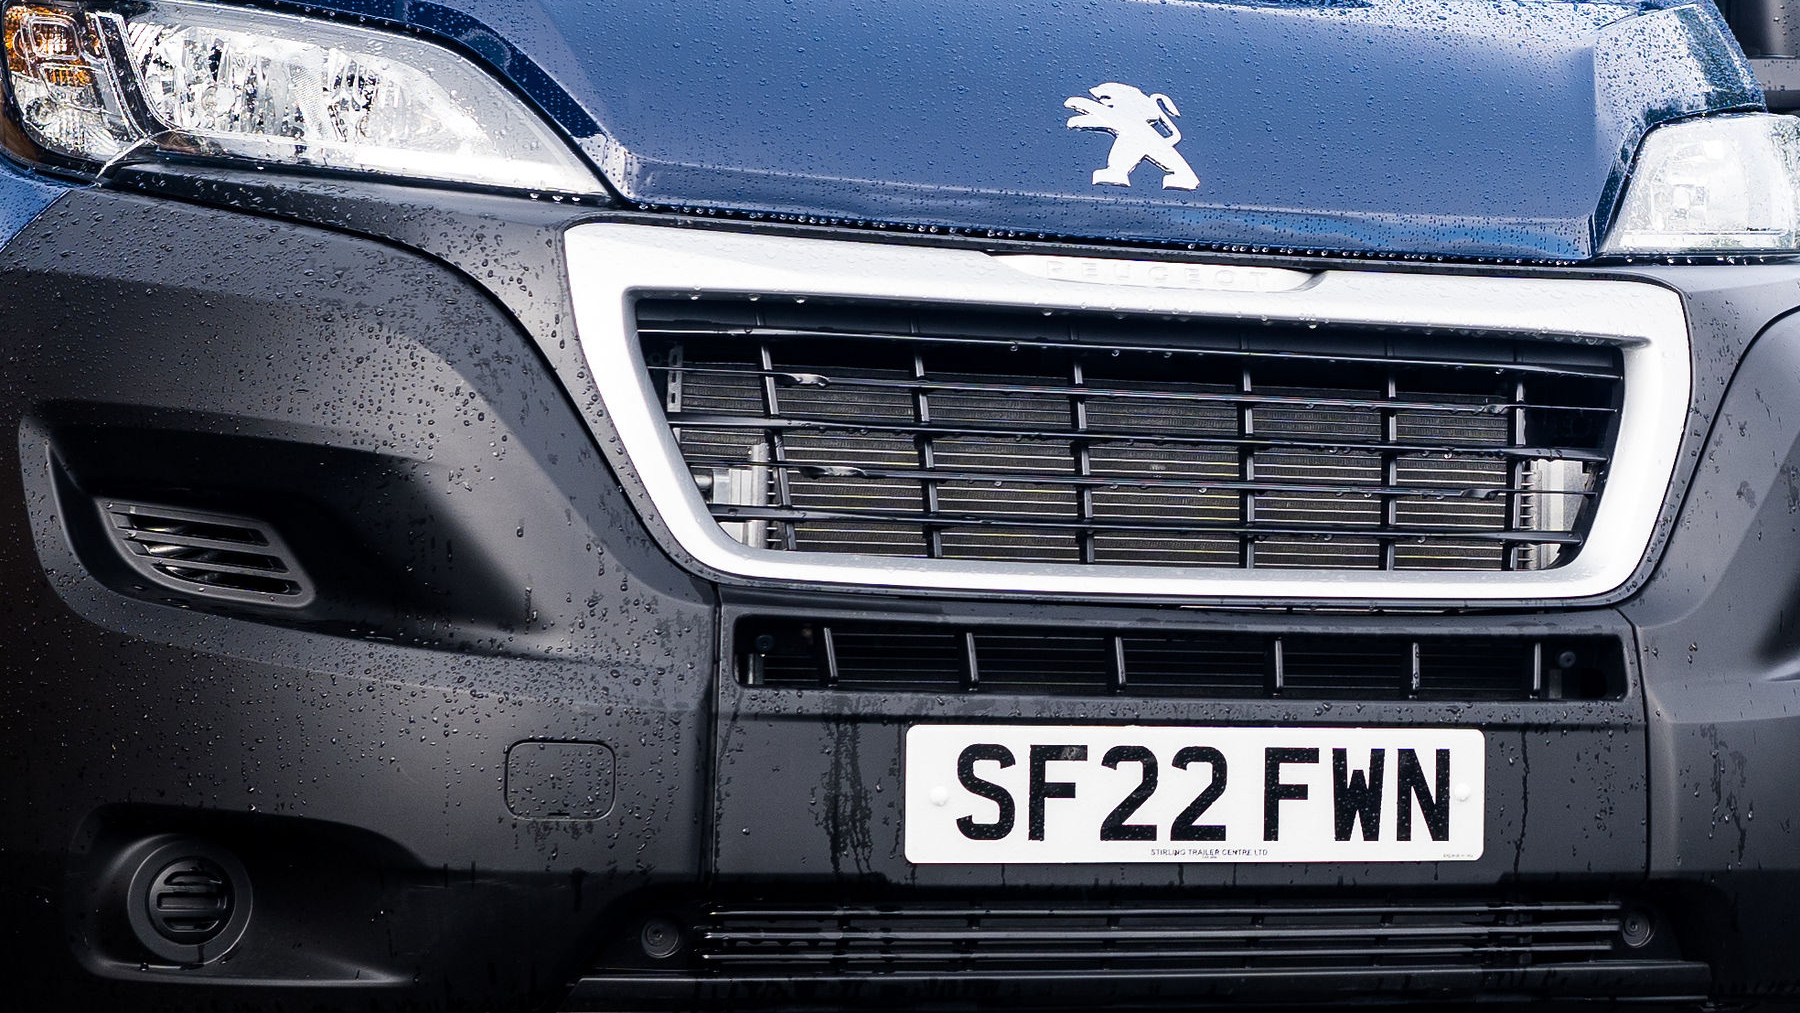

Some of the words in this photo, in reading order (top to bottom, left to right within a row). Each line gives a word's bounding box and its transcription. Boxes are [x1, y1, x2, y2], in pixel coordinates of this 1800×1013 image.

[1047, 259, 1268, 288] PEUGEOT
[956, 743, 1228, 841] SF22
[1262, 746, 1451, 842] FWN
[1150, 848, 1186, 856] STIRLING
[1188, 848, 1220, 856] TRAILER
[1221, 848, 1252, 856] CENTRE
[1254, 848, 1269, 856] LTD
